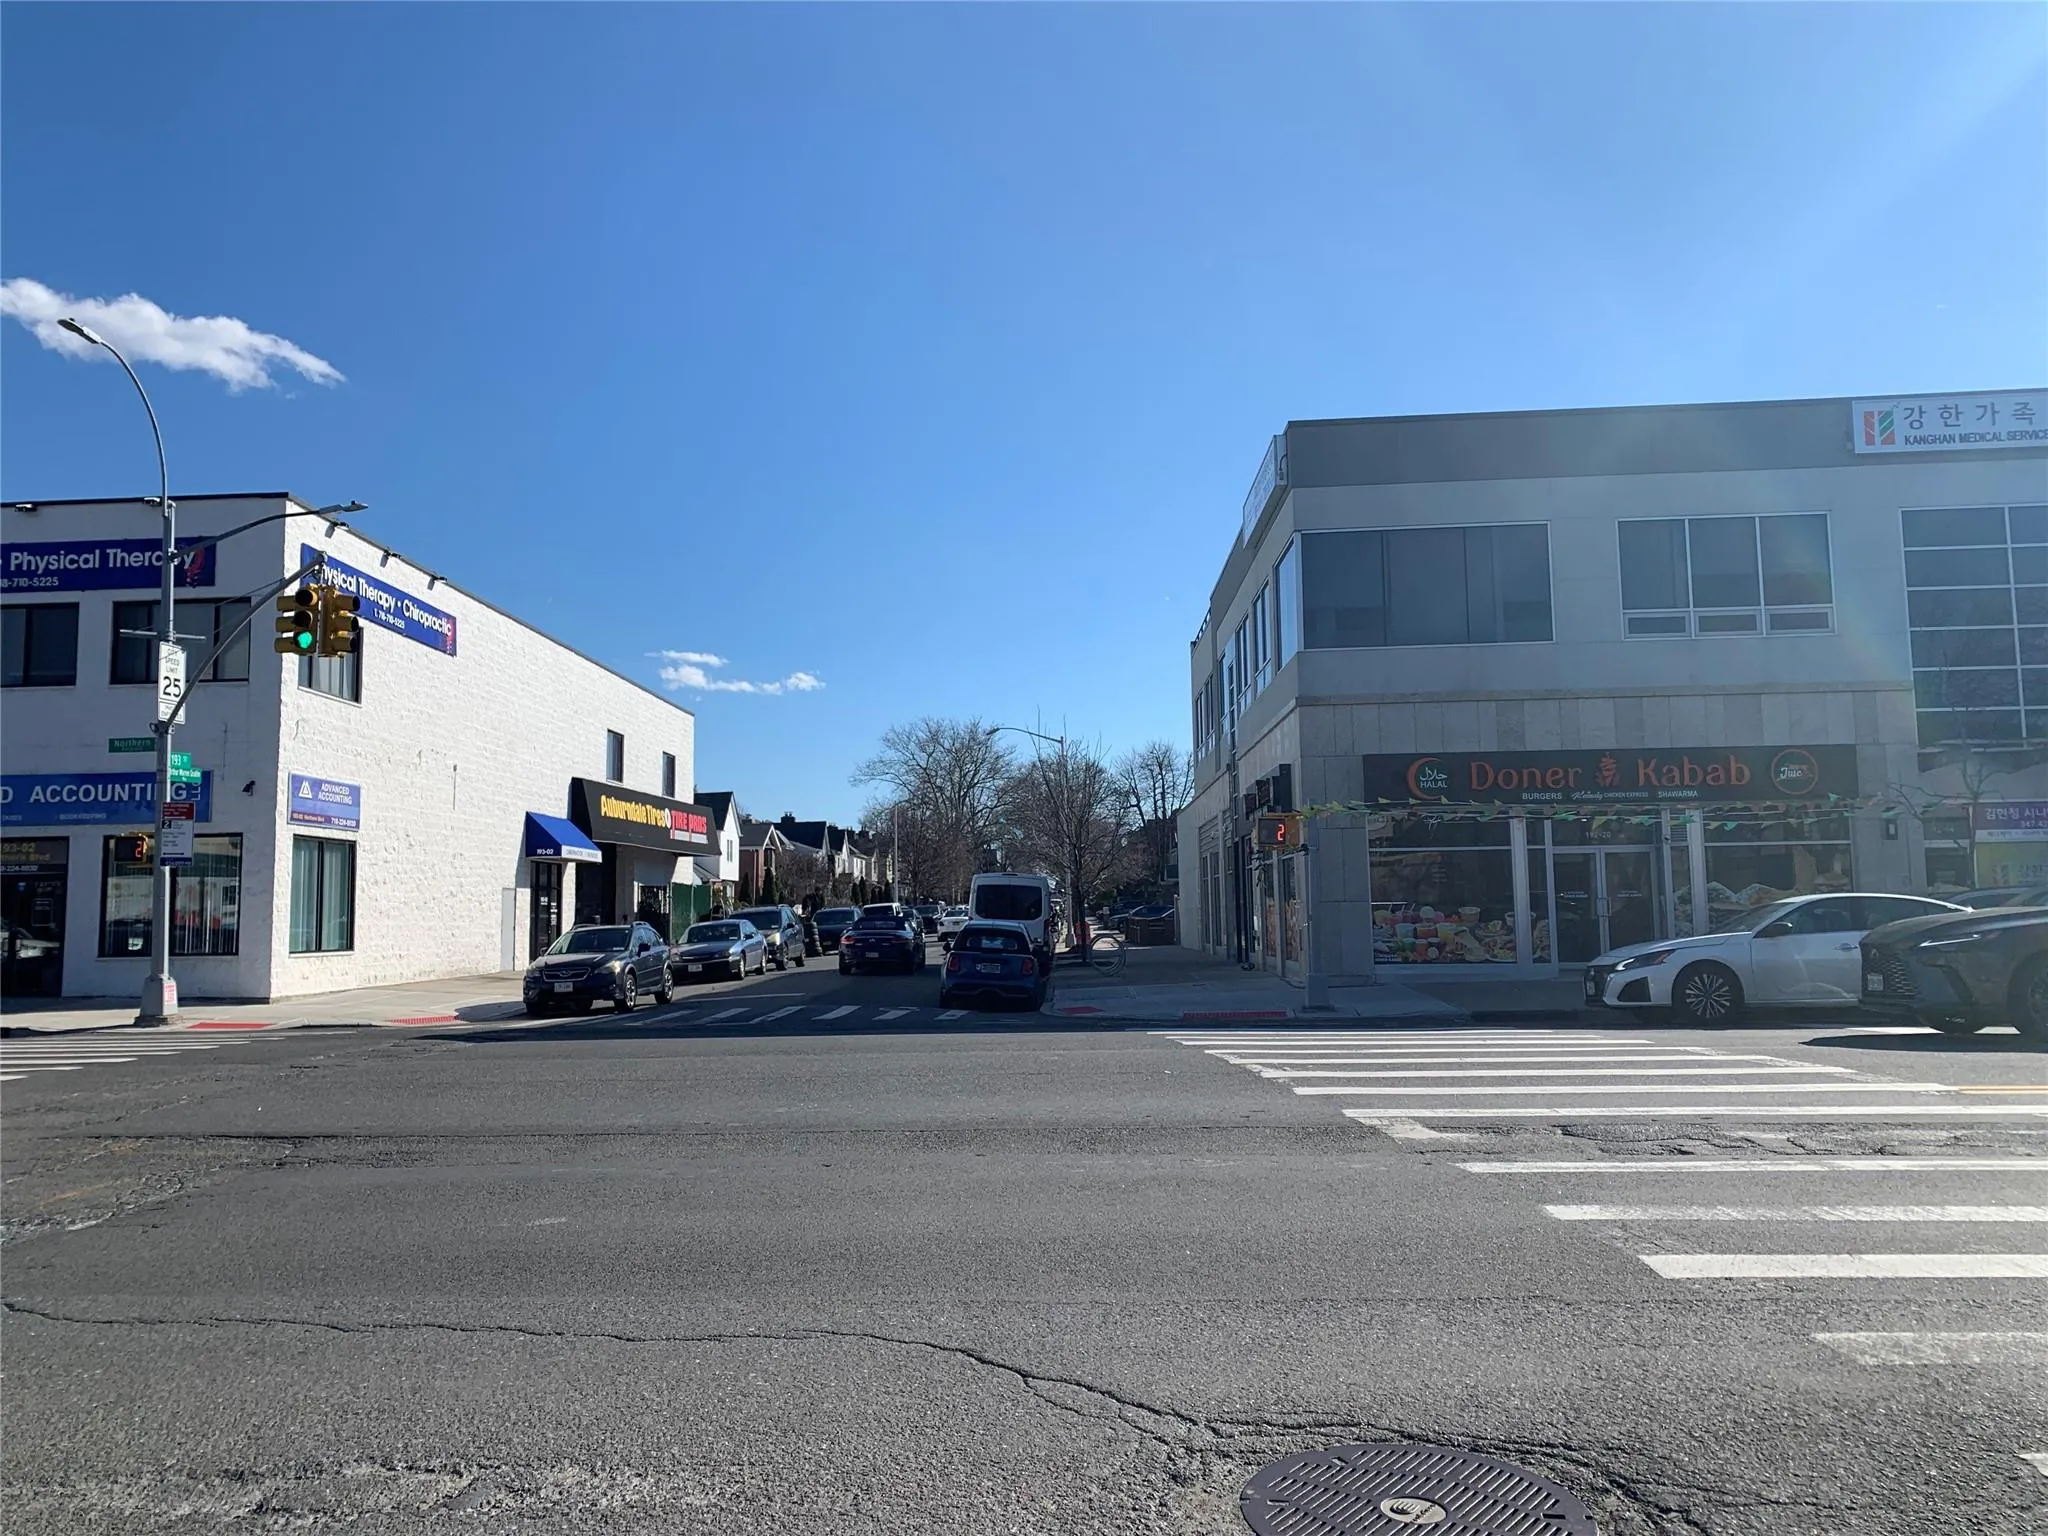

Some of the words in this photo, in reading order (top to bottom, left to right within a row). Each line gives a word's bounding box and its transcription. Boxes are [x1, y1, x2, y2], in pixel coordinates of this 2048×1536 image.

[1905, 433, 1956, 446] KANGHAN
[1959, 431, 2005, 444] MEDICAL
[10, 550, 100, 573] Physical
[106, 548, 195, 570] Theray
[320, 562, 357, 593] hysical
[358, 577, 396, 611] Therapy
[402, 599, 452, 637] Chiropractic
[163, 676, 181, 698] 25
[114, 739, 151, 747] Northern
[1470, 761, 1583, 790] Doner
[1637, 754, 1751, 787] Kabab
[29, 782, 187, 803] ACCOUNTIG
[321, 783, 350, 795] ADVANCED
[1420, 780, 1448, 789] HALAL
[318, 792, 353, 805] ACCOUNTING
[1522, 792, 1562, 800] BURGERS
[1658, 789, 1699, 798] SHAWARMA
[601, 794, 646, 824] Auburndale
[646, 804, 666, 828] Tires
[671, 810, 688, 834] TIRE
[1277, 824, 1284, 841] 2
